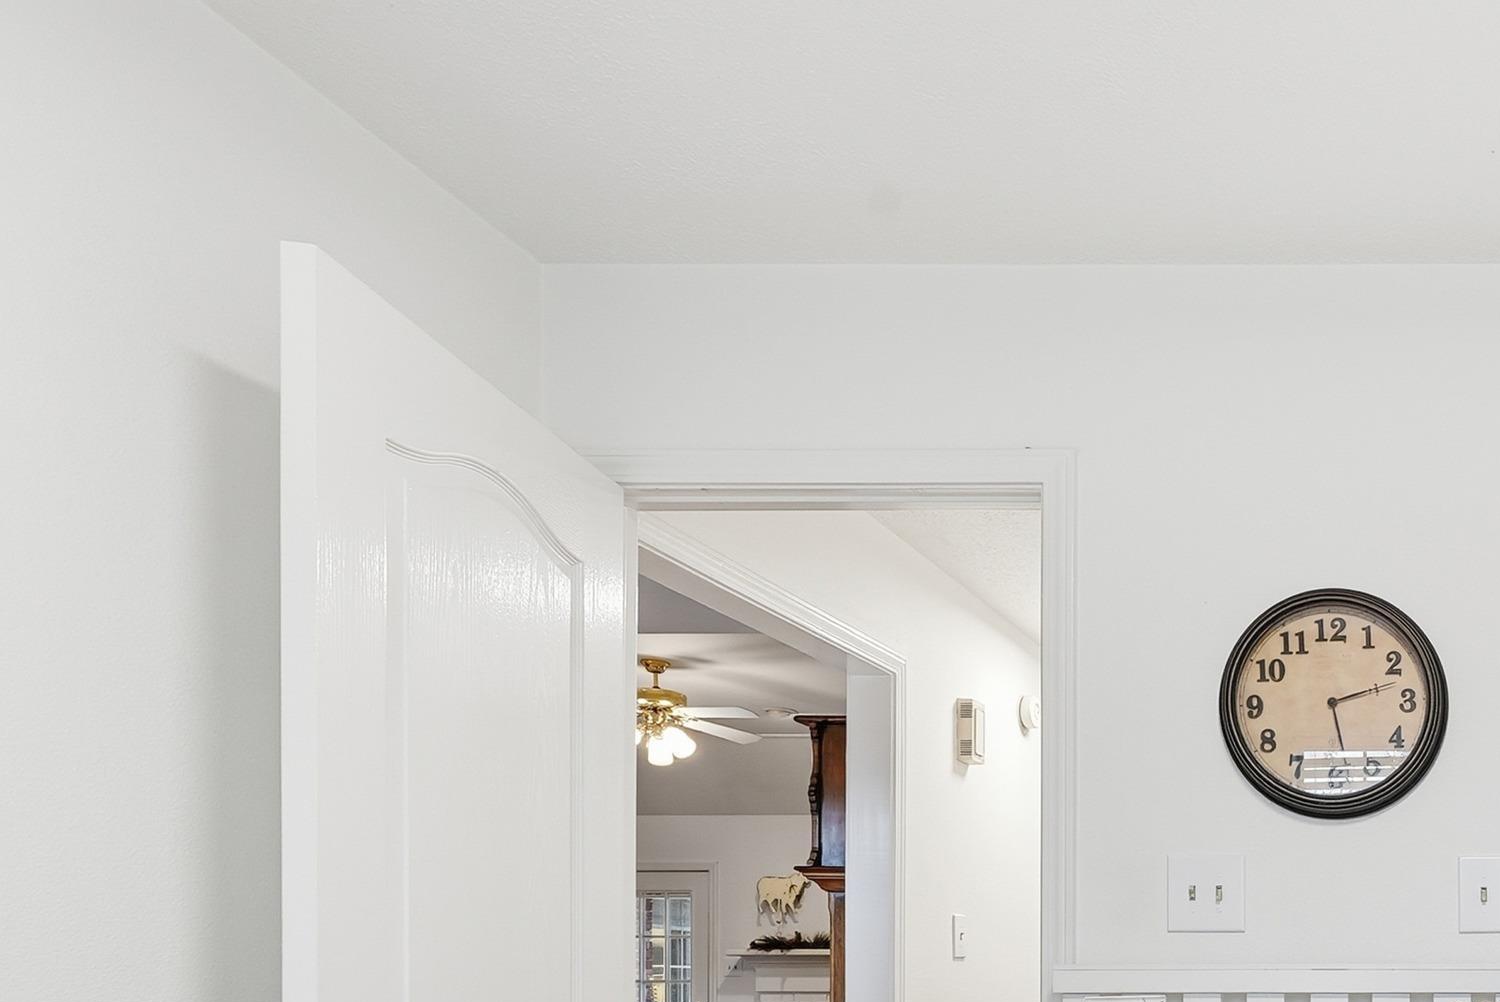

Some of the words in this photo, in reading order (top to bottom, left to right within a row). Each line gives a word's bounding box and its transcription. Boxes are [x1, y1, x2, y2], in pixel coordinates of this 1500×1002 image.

[1314, 617, 1347, 643] 12
[1361, 624, 1375, 650] 1
[1279, 630, 1309, 656] 11
[1255, 658, 1286, 683] 10
[1385, 650, 1402, 677] 2
[1246, 694, 1264, 719] 9
[1398, 688, 1417, 713] 3
[1259, 728, 1277, 753] 8
[1388, 725, 1405, 749] 4
[1289, 753, 1305, 780] 7
